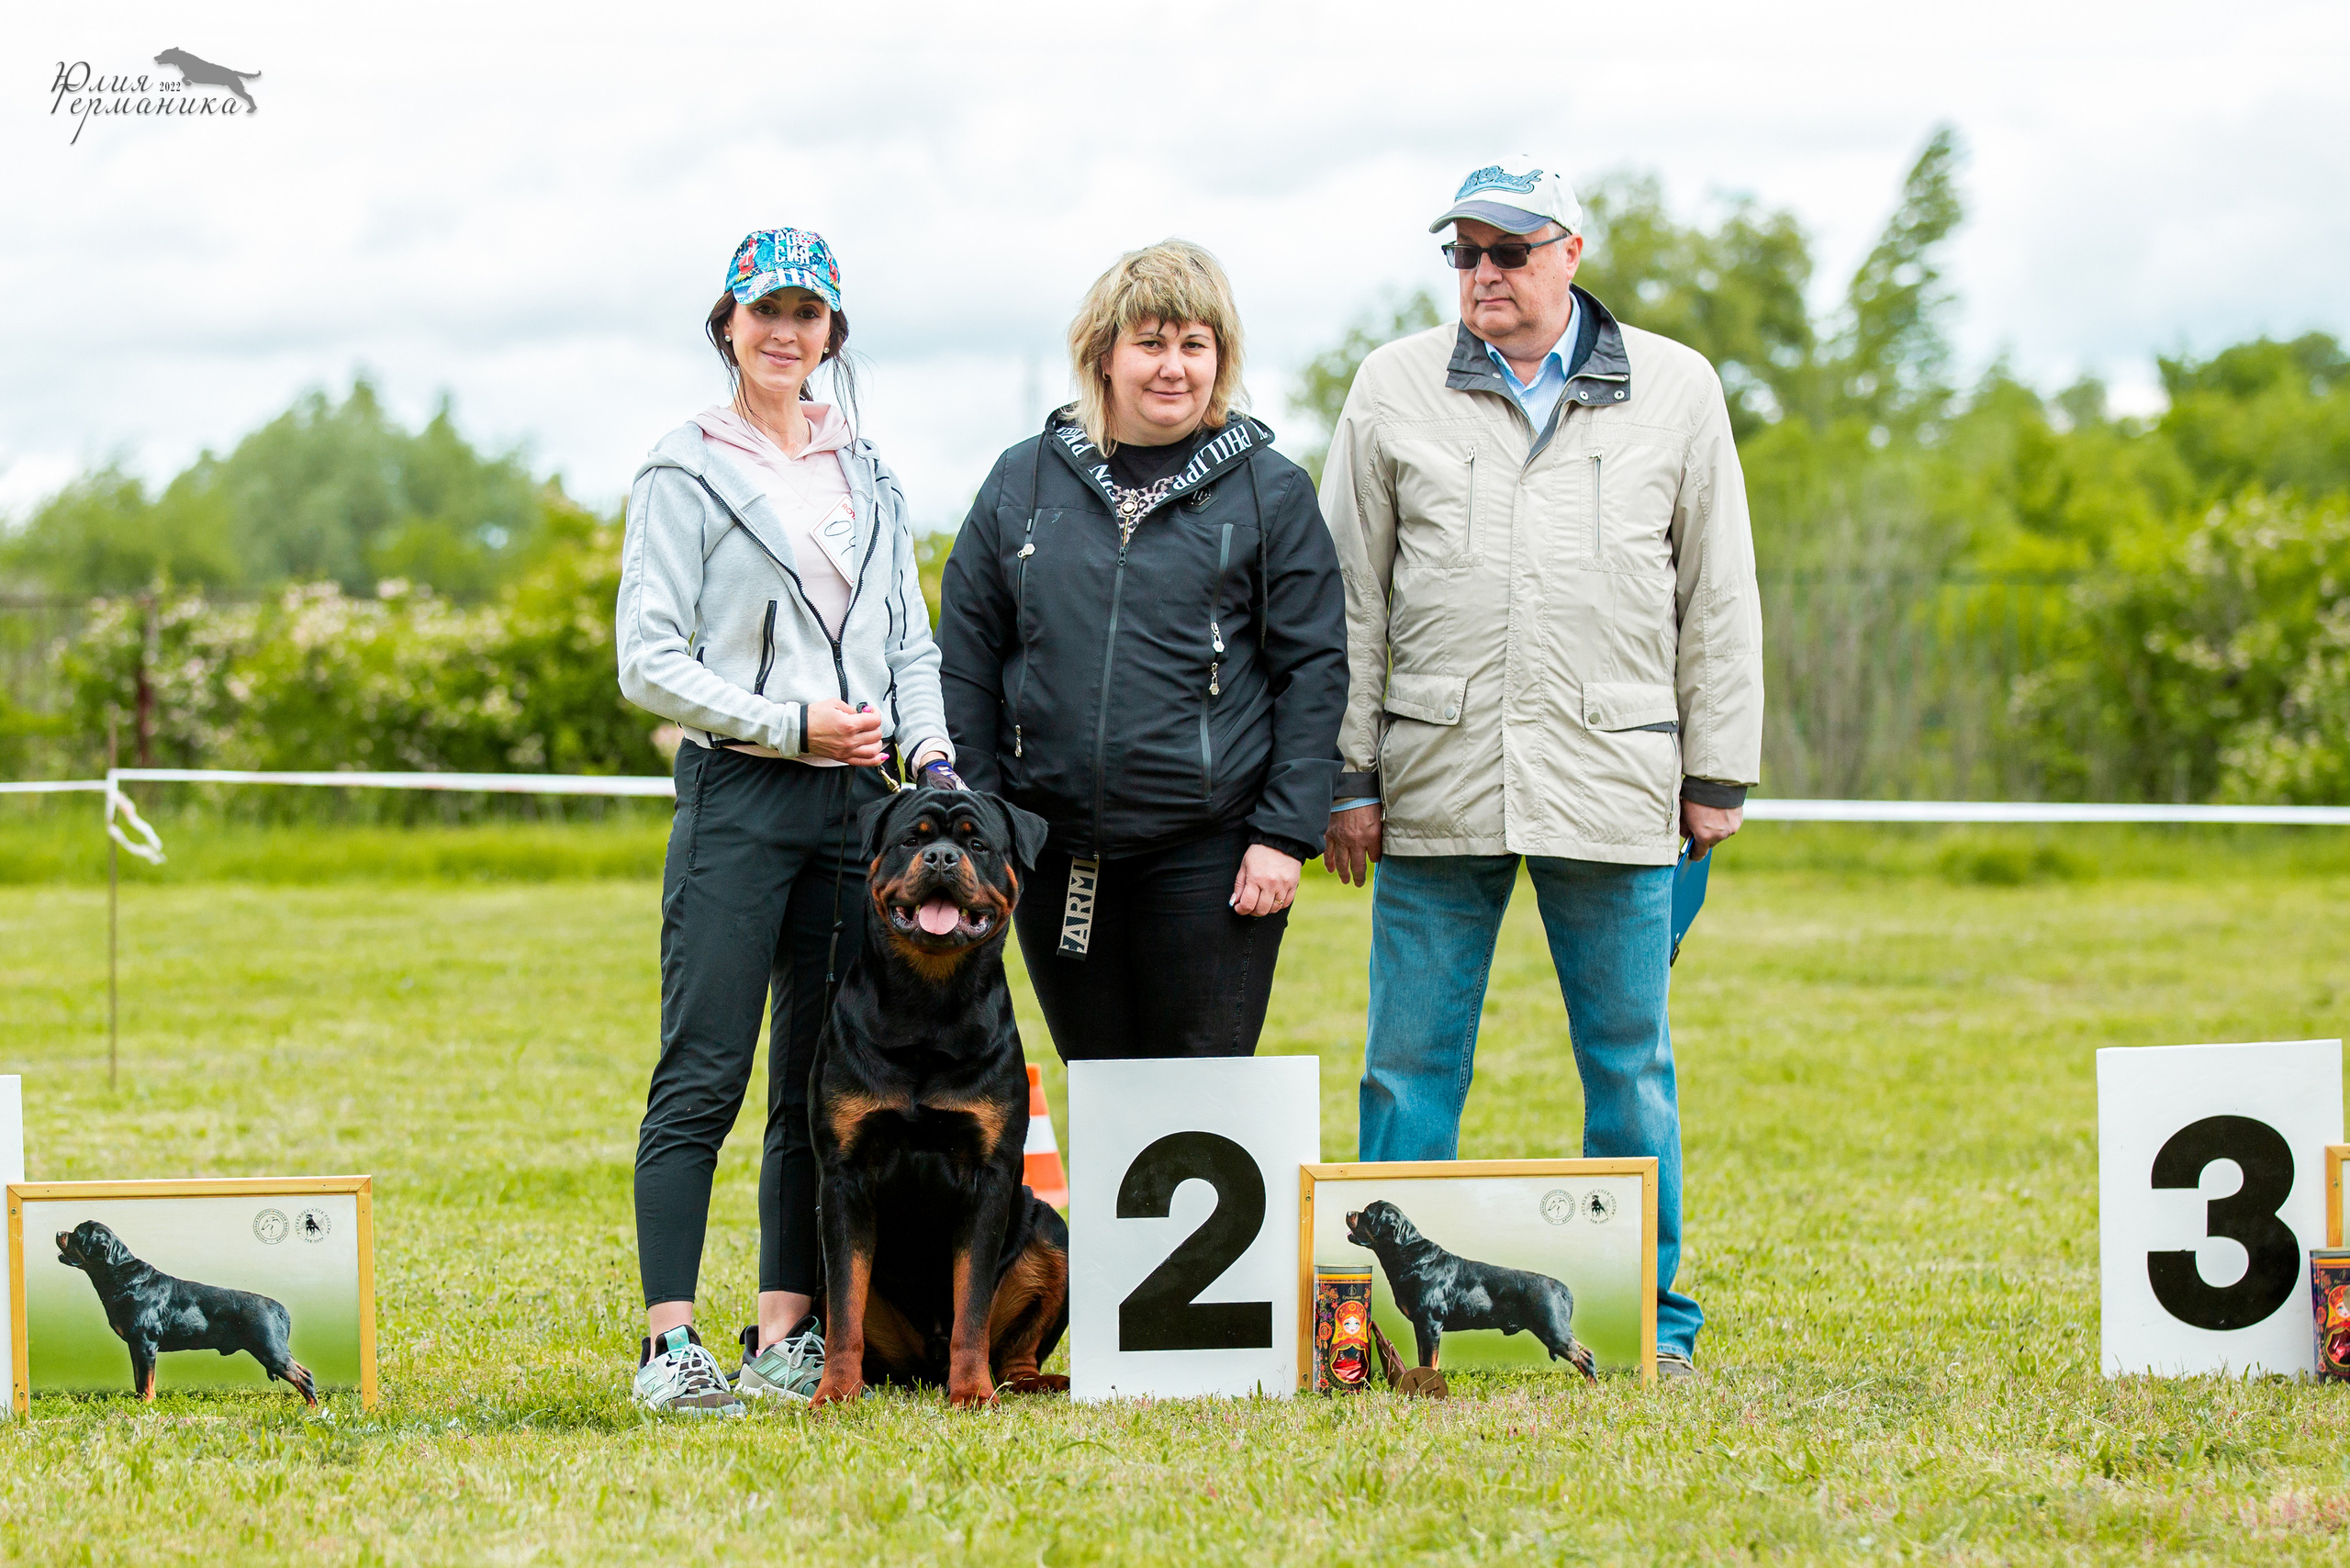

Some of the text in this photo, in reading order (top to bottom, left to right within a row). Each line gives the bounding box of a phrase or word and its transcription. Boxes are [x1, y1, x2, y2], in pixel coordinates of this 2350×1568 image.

[774, 245, 811, 265] СИЯ
[1172, 423, 1253, 490] PHILIPP
[1116, 1131, 1272, 1351] 2
[2147, 1114, 2300, 1331] 3
